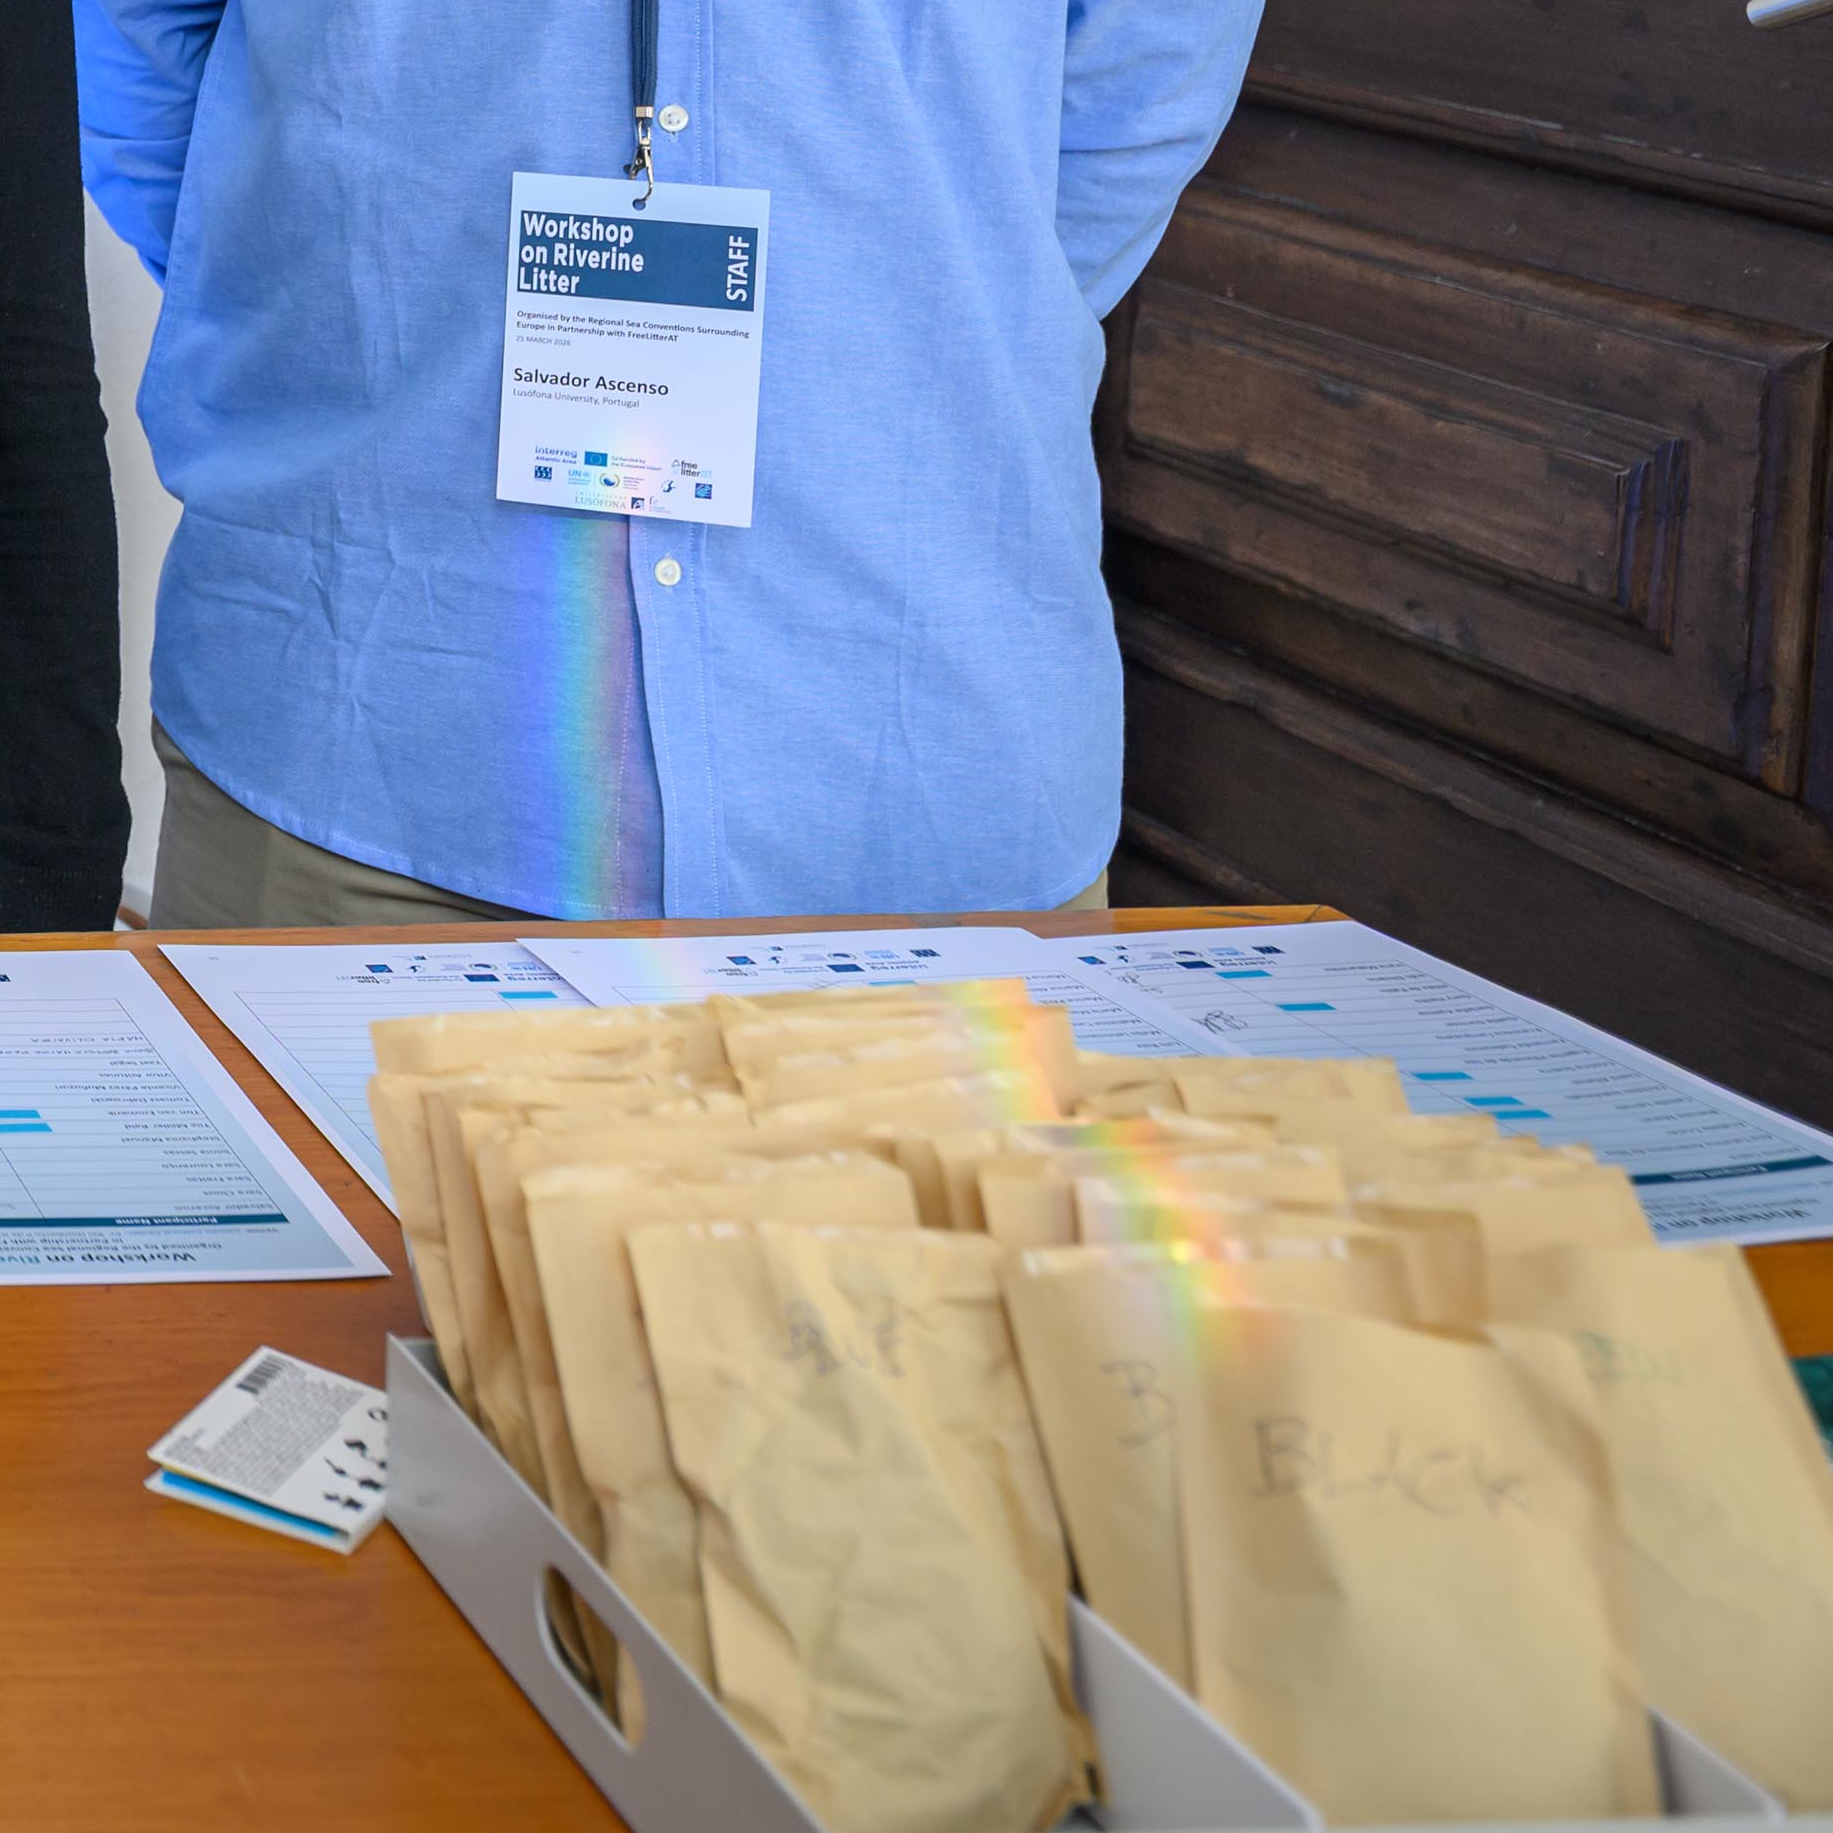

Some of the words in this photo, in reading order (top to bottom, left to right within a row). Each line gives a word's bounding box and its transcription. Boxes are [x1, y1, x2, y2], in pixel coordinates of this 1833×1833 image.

[523, 213, 634, 247] Workshop
[521, 245, 548, 265] on
[554, 243, 645, 272] Riverine
[726, 236, 750, 301] STAFF
[519, 268, 580, 295] Litter
[517, 310, 558, 321] Organised
[560, 315, 571, 323] by
[572, 315, 586, 323] the
[588, 317, 624, 326] Regional
[626, 320, 640, 328] Sea
[643, 322, 695, 333] Conventions
[697, 326, 749, 338] Surrounding
[517, 322, 545, 331] Europe
[558, 325, 604, 337] Partnership
[607, 329, 625, 337] with
[628, 331, 678, 342] FreeLitterAT
[526, 336, 552, 344] MARCH
[513, 367, 590, 387] Salvador
[595, 376, 669, 396] Ascenso
[513, 389, 552, 400] Lusófona
[554, 393, 600, 405] University,
[603, 397, 639, 409] Portugal
[115, 1217, 150, 1225] Name
[153, 1216, 217, 1224] Participant
[46, 1255, 74, 1264] on
[81, 1252, 196, 1264] Workshop
